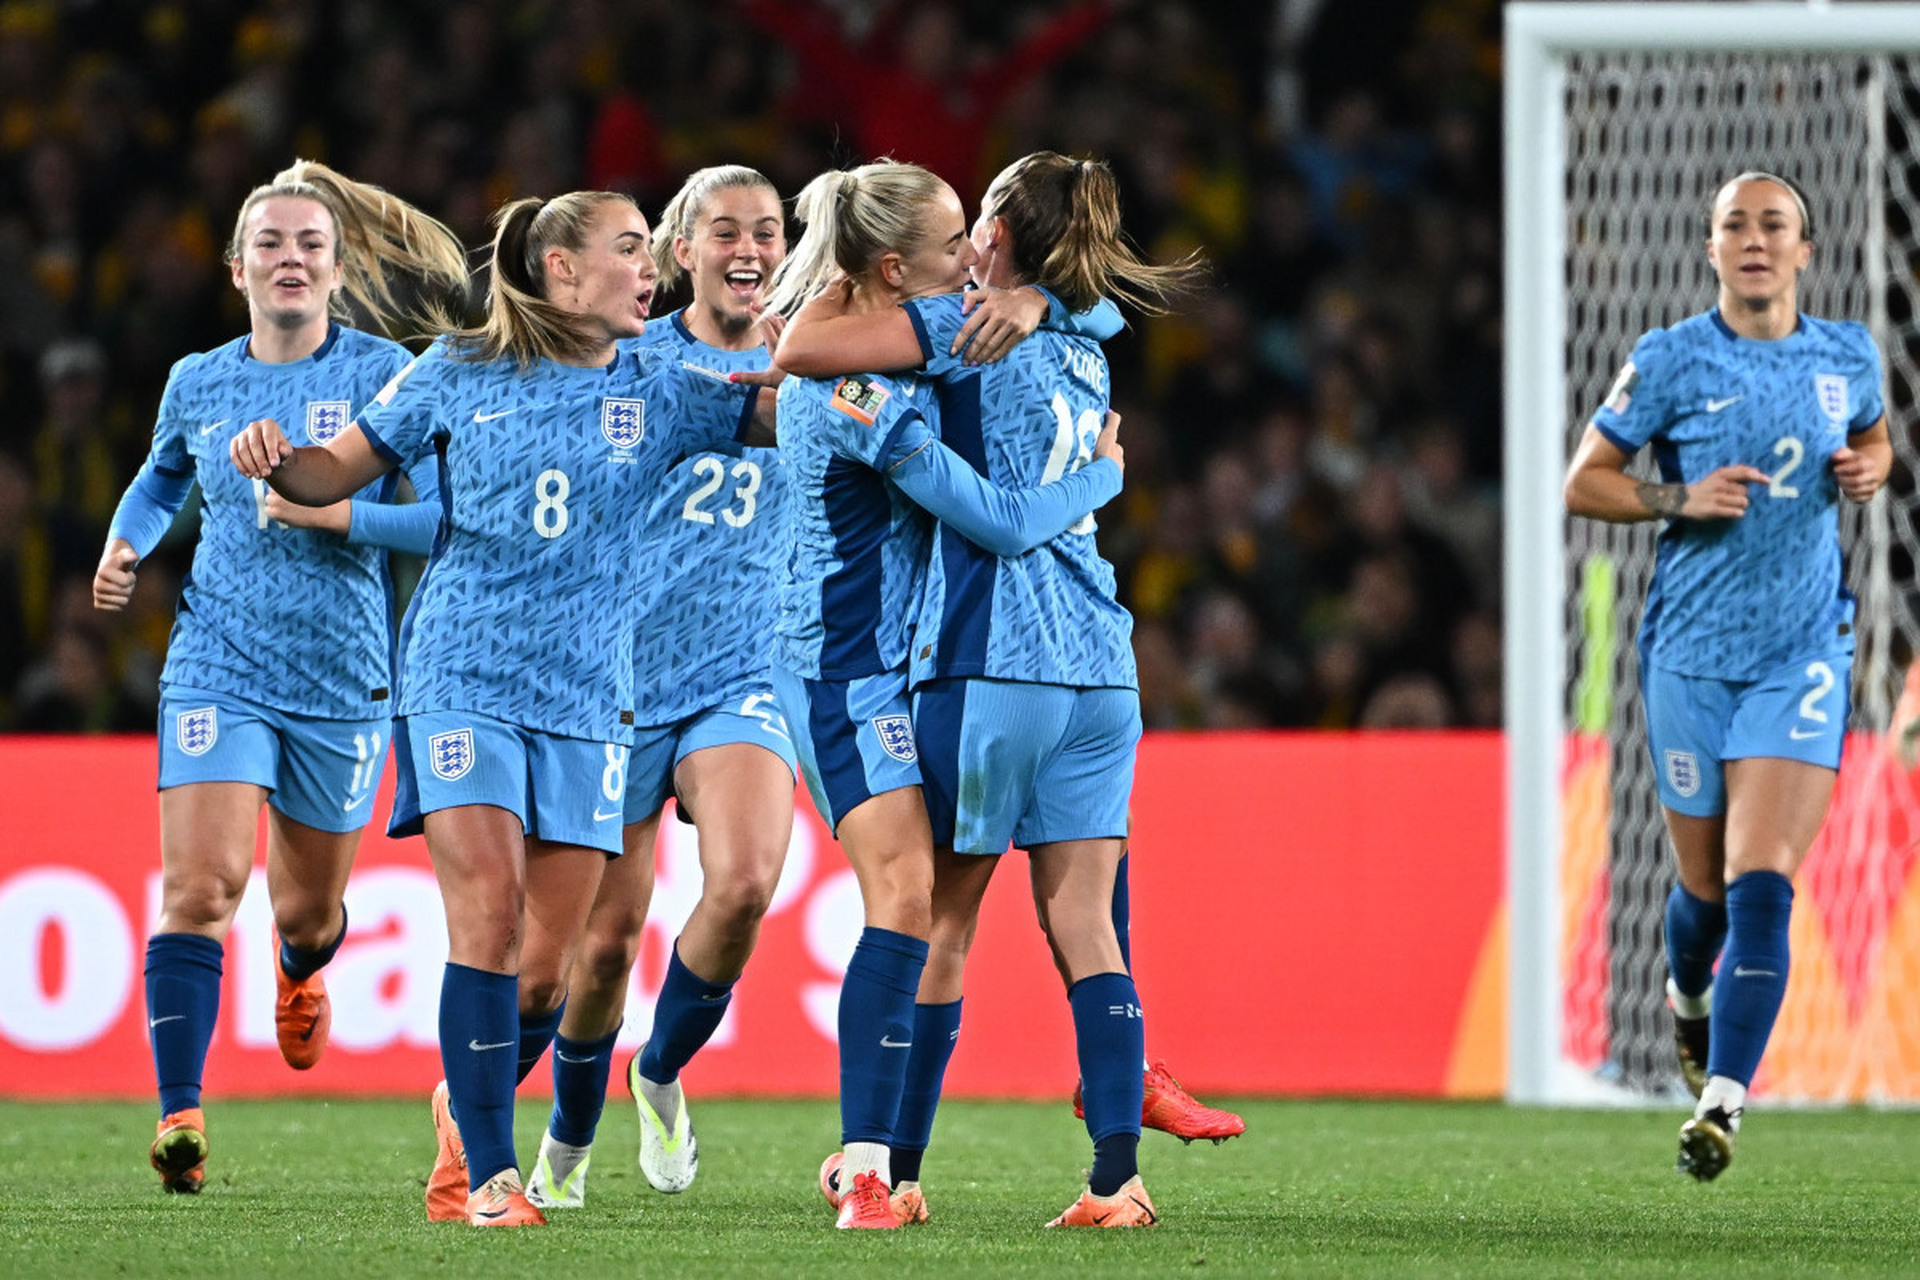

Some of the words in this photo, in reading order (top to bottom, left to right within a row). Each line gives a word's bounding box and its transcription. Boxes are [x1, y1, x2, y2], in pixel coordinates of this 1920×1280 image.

[682, 457, 762, 528] 23
[1769, 436, 1804, 498] 2
[533, 468, 570, 538] 8
[1800, 661, 1834, 722] 2
[351, 731, 381, 793] 11
[602, 743, 626, 801] 8
